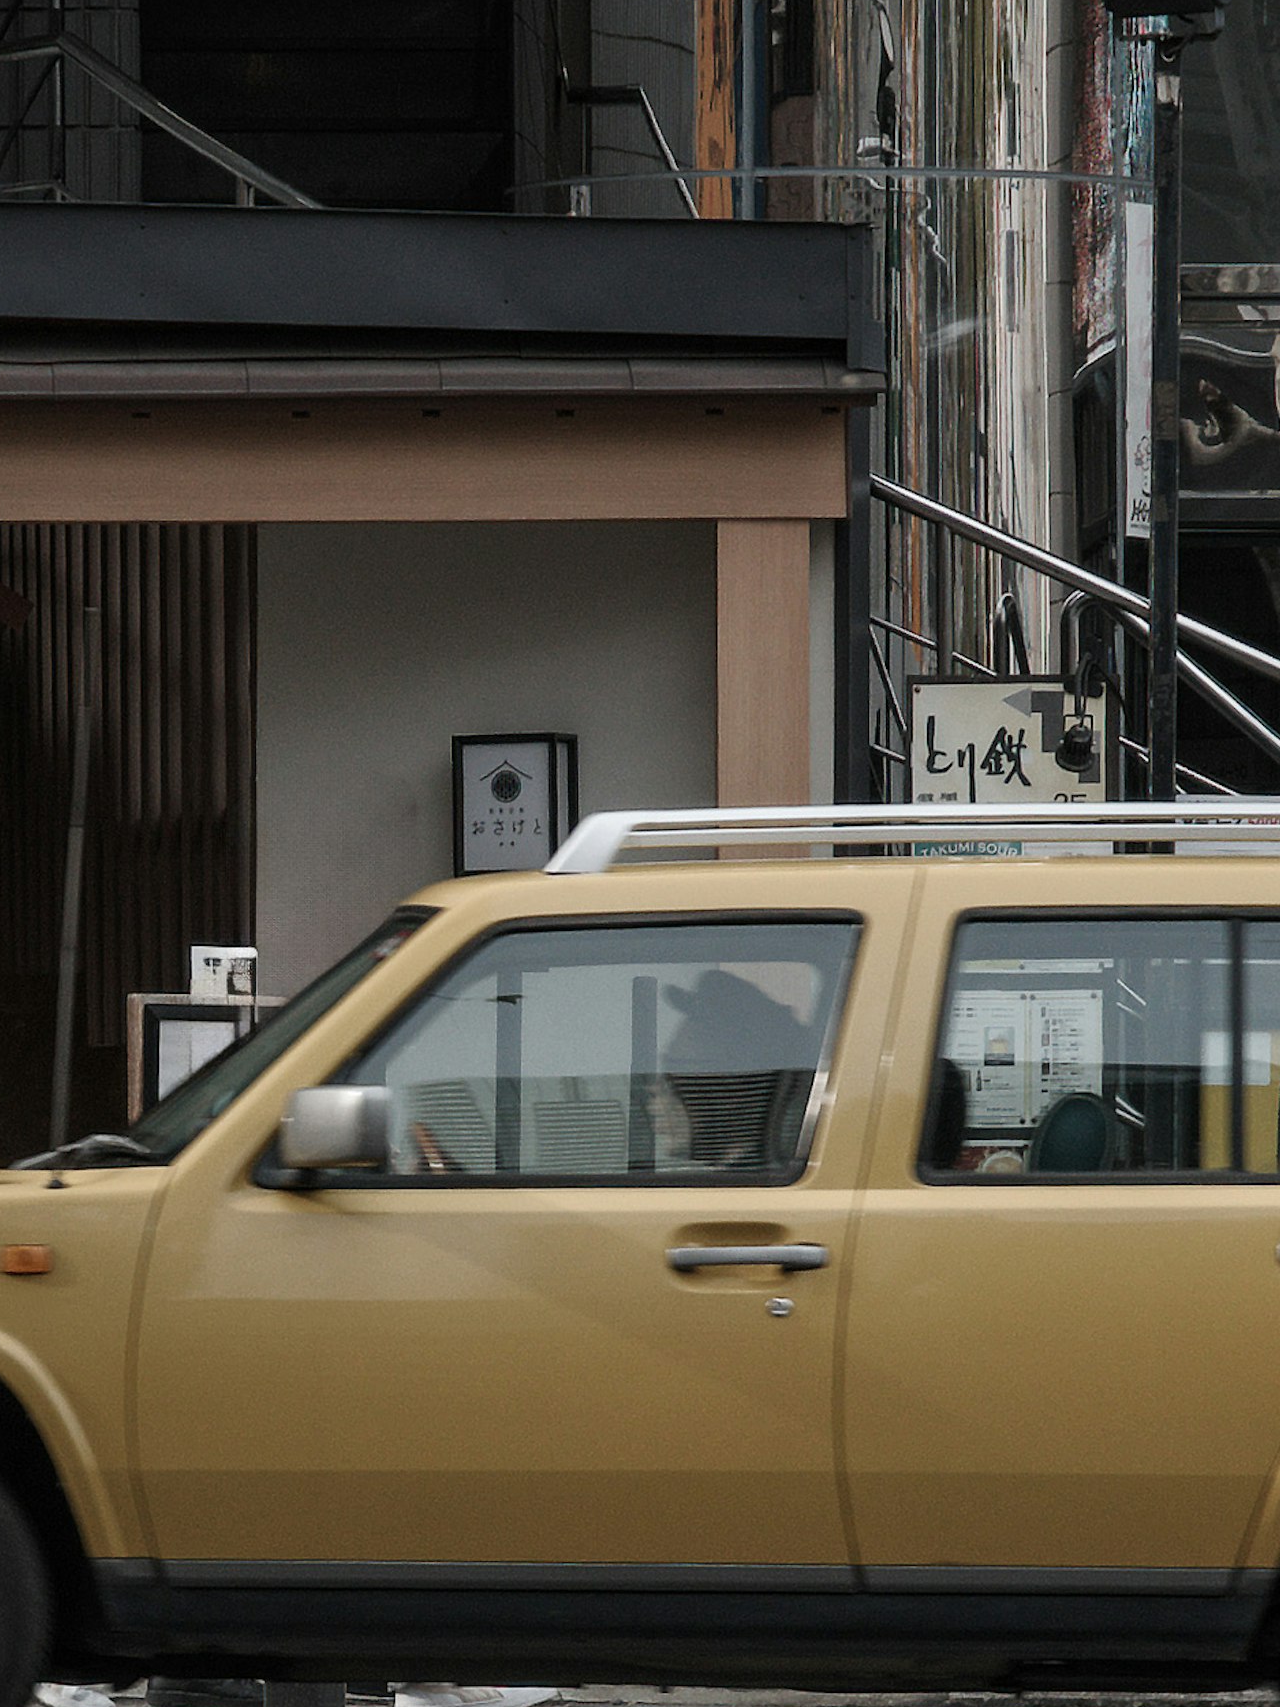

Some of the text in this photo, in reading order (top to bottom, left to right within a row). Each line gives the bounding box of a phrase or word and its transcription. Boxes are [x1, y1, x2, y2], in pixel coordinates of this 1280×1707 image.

[926, 715, 1032, 803] とり鉄
[920, 842, 974, 856] TAKUMI
